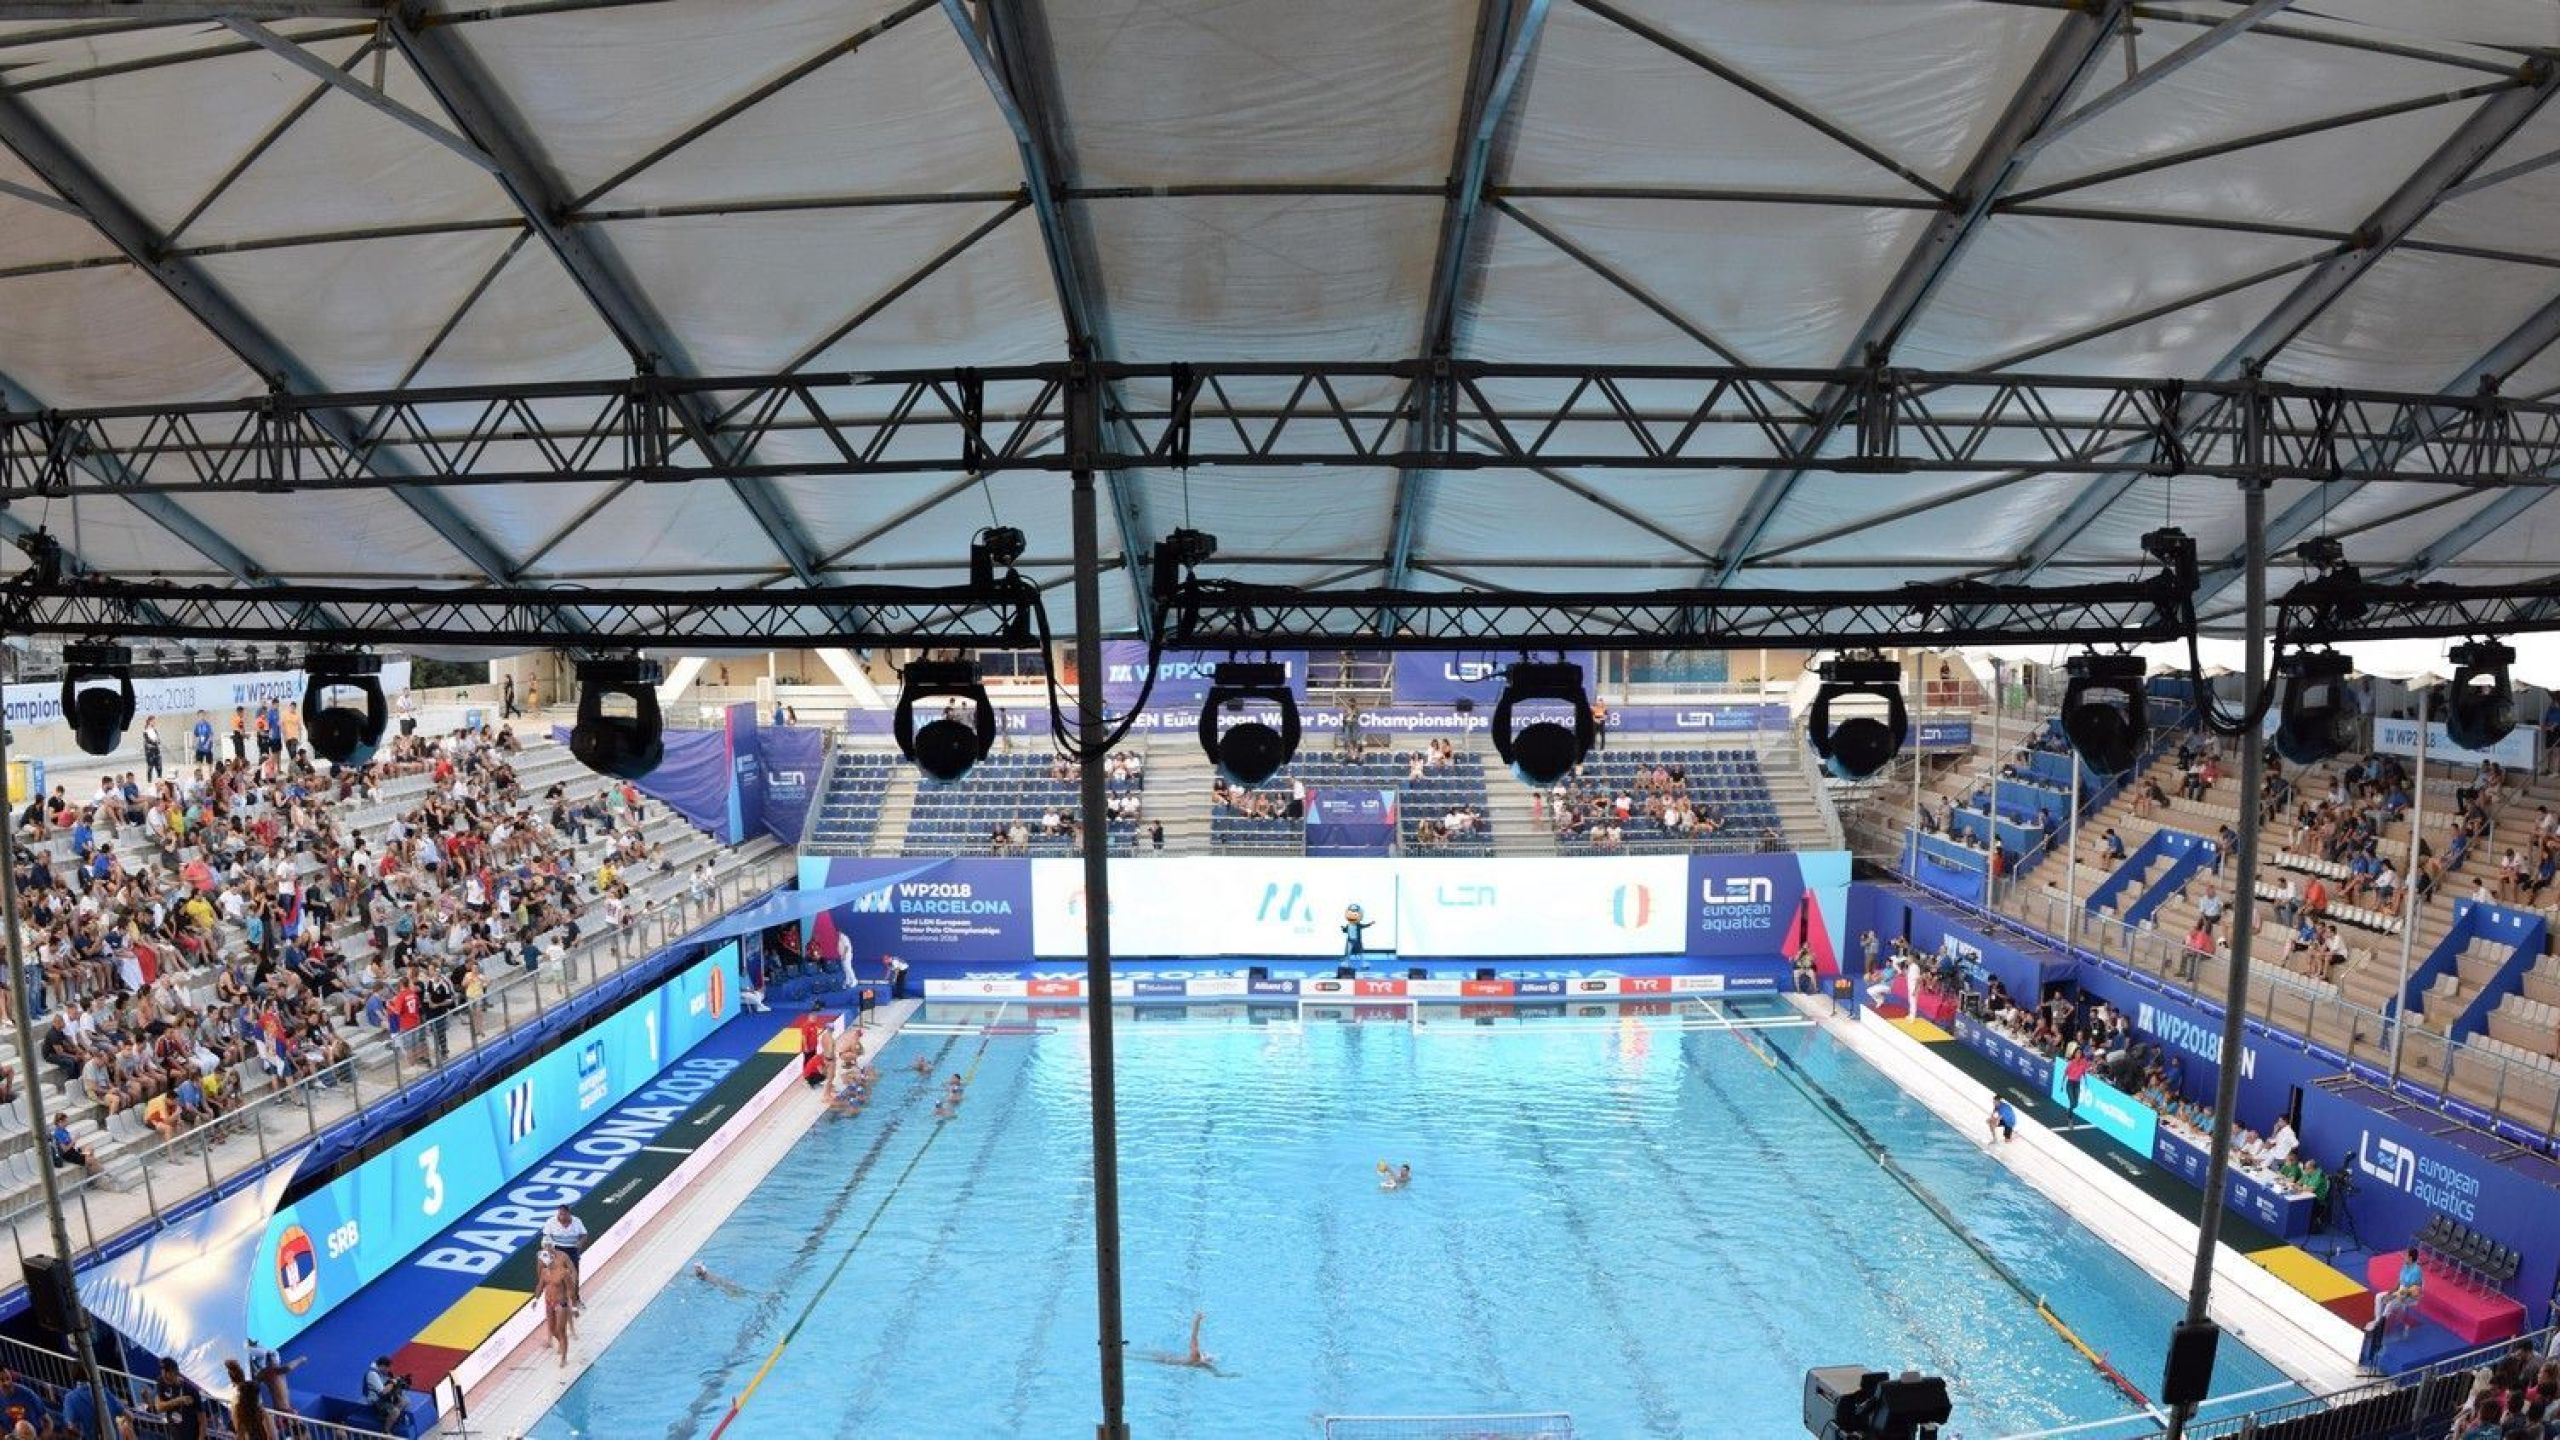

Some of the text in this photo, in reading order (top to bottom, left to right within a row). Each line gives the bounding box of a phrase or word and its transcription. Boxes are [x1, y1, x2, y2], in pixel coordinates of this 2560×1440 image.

[1358, 712, 1489, 730] Championships
[1677, 712, 1714, 726] LEN
[768, 771, 805, 786] LEN
[900, 884, 972, 898] WP2018
[1703, 877, 1773, 903] LEN
[901, 899, 1013, 915] BARCELONA
[1702, 903, 1772, 918] european
[1702, 915, 1771, 932] aquatics
[1366, 981, 1393, 993] TYR
[1633, 979, 1659, 990] TYR
[644, 1008, 657, 1062] 1
[2359, 1130, 2416, 1194] LEN
[418, 1144, 444, 1216] 3
[2418, 1156, 2480, 1198] european
[2414, 1179, 2476, 1223] aquatics
[327, 1219, 359, 1259] SRB
